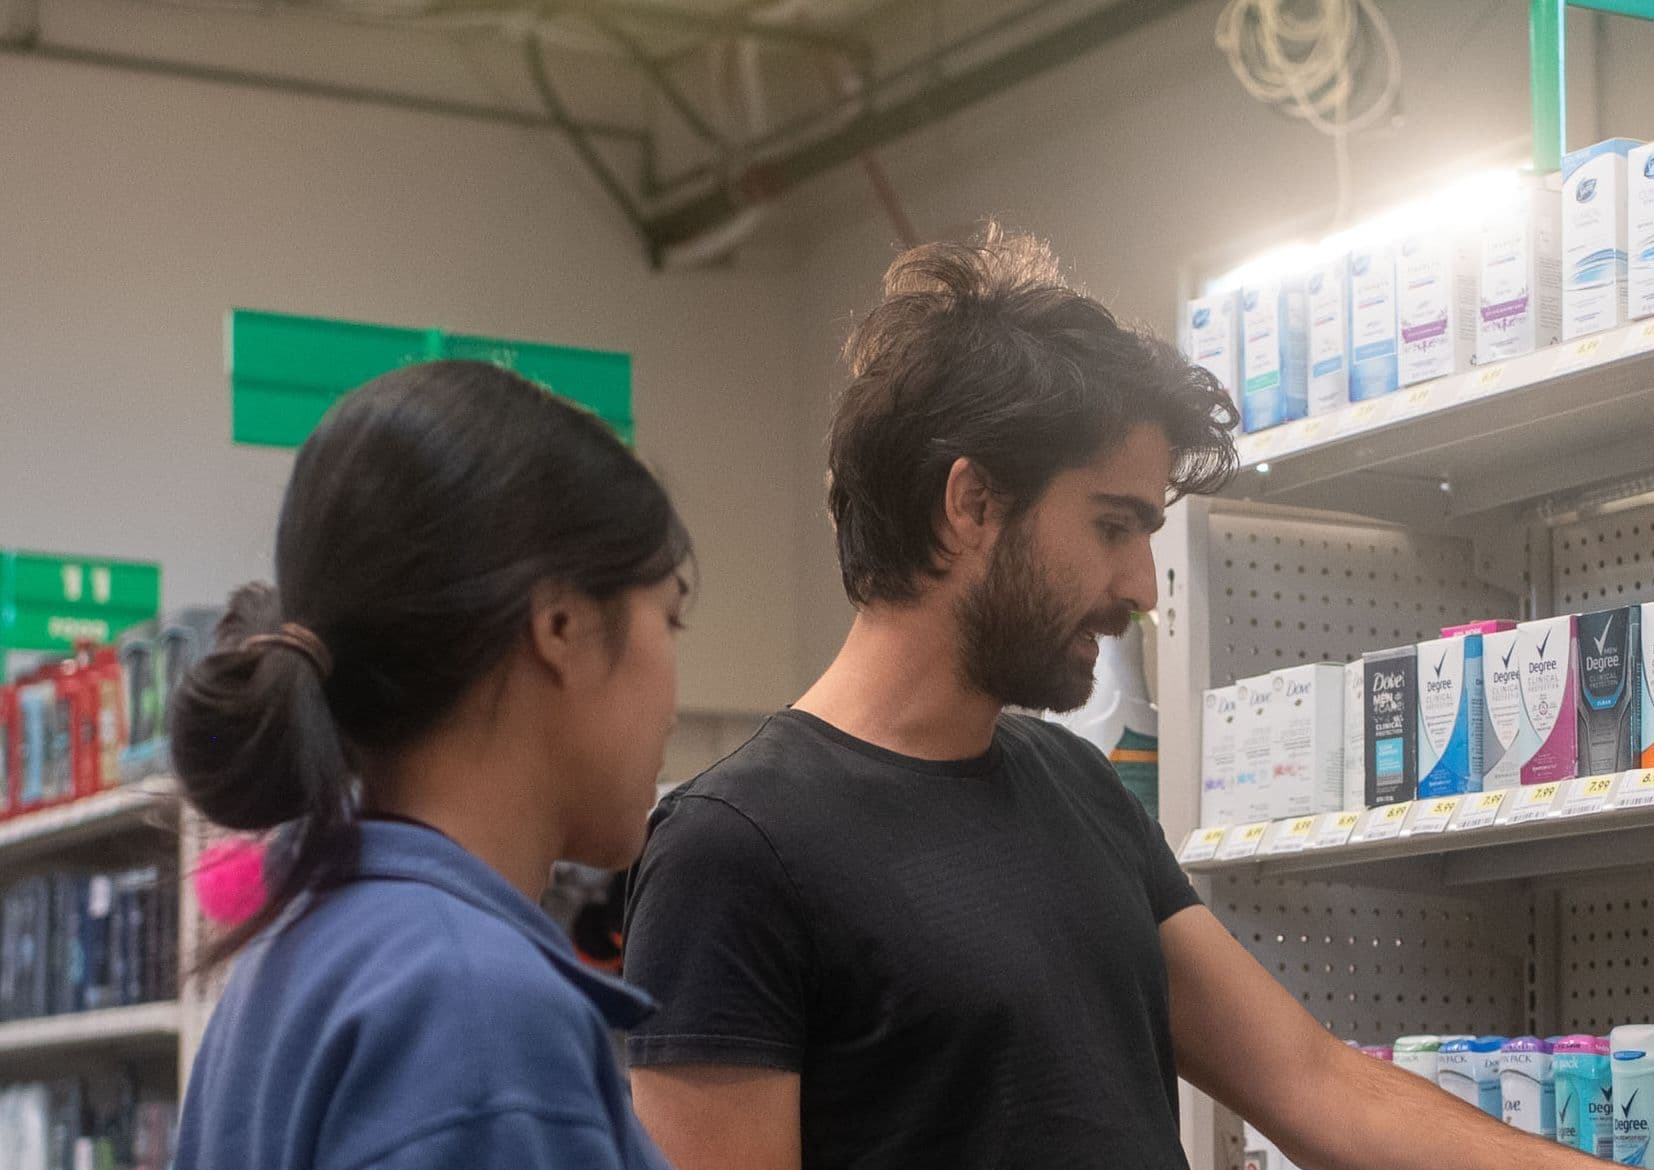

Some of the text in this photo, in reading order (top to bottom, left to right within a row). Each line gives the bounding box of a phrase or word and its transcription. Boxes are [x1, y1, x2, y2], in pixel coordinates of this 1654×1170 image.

[1529, 659, 1557, 674] Degree
[1587, 654, 1619, 671] Degree
[1373, 671, 1404, 692] Dove
[1427, 680, 1452, 694] Degree
[1590, 780, 1611, 792] 7.99
[1504, 1100, 1521, 1112] ove
[1615, 1118, 1648, 1134] Degree
